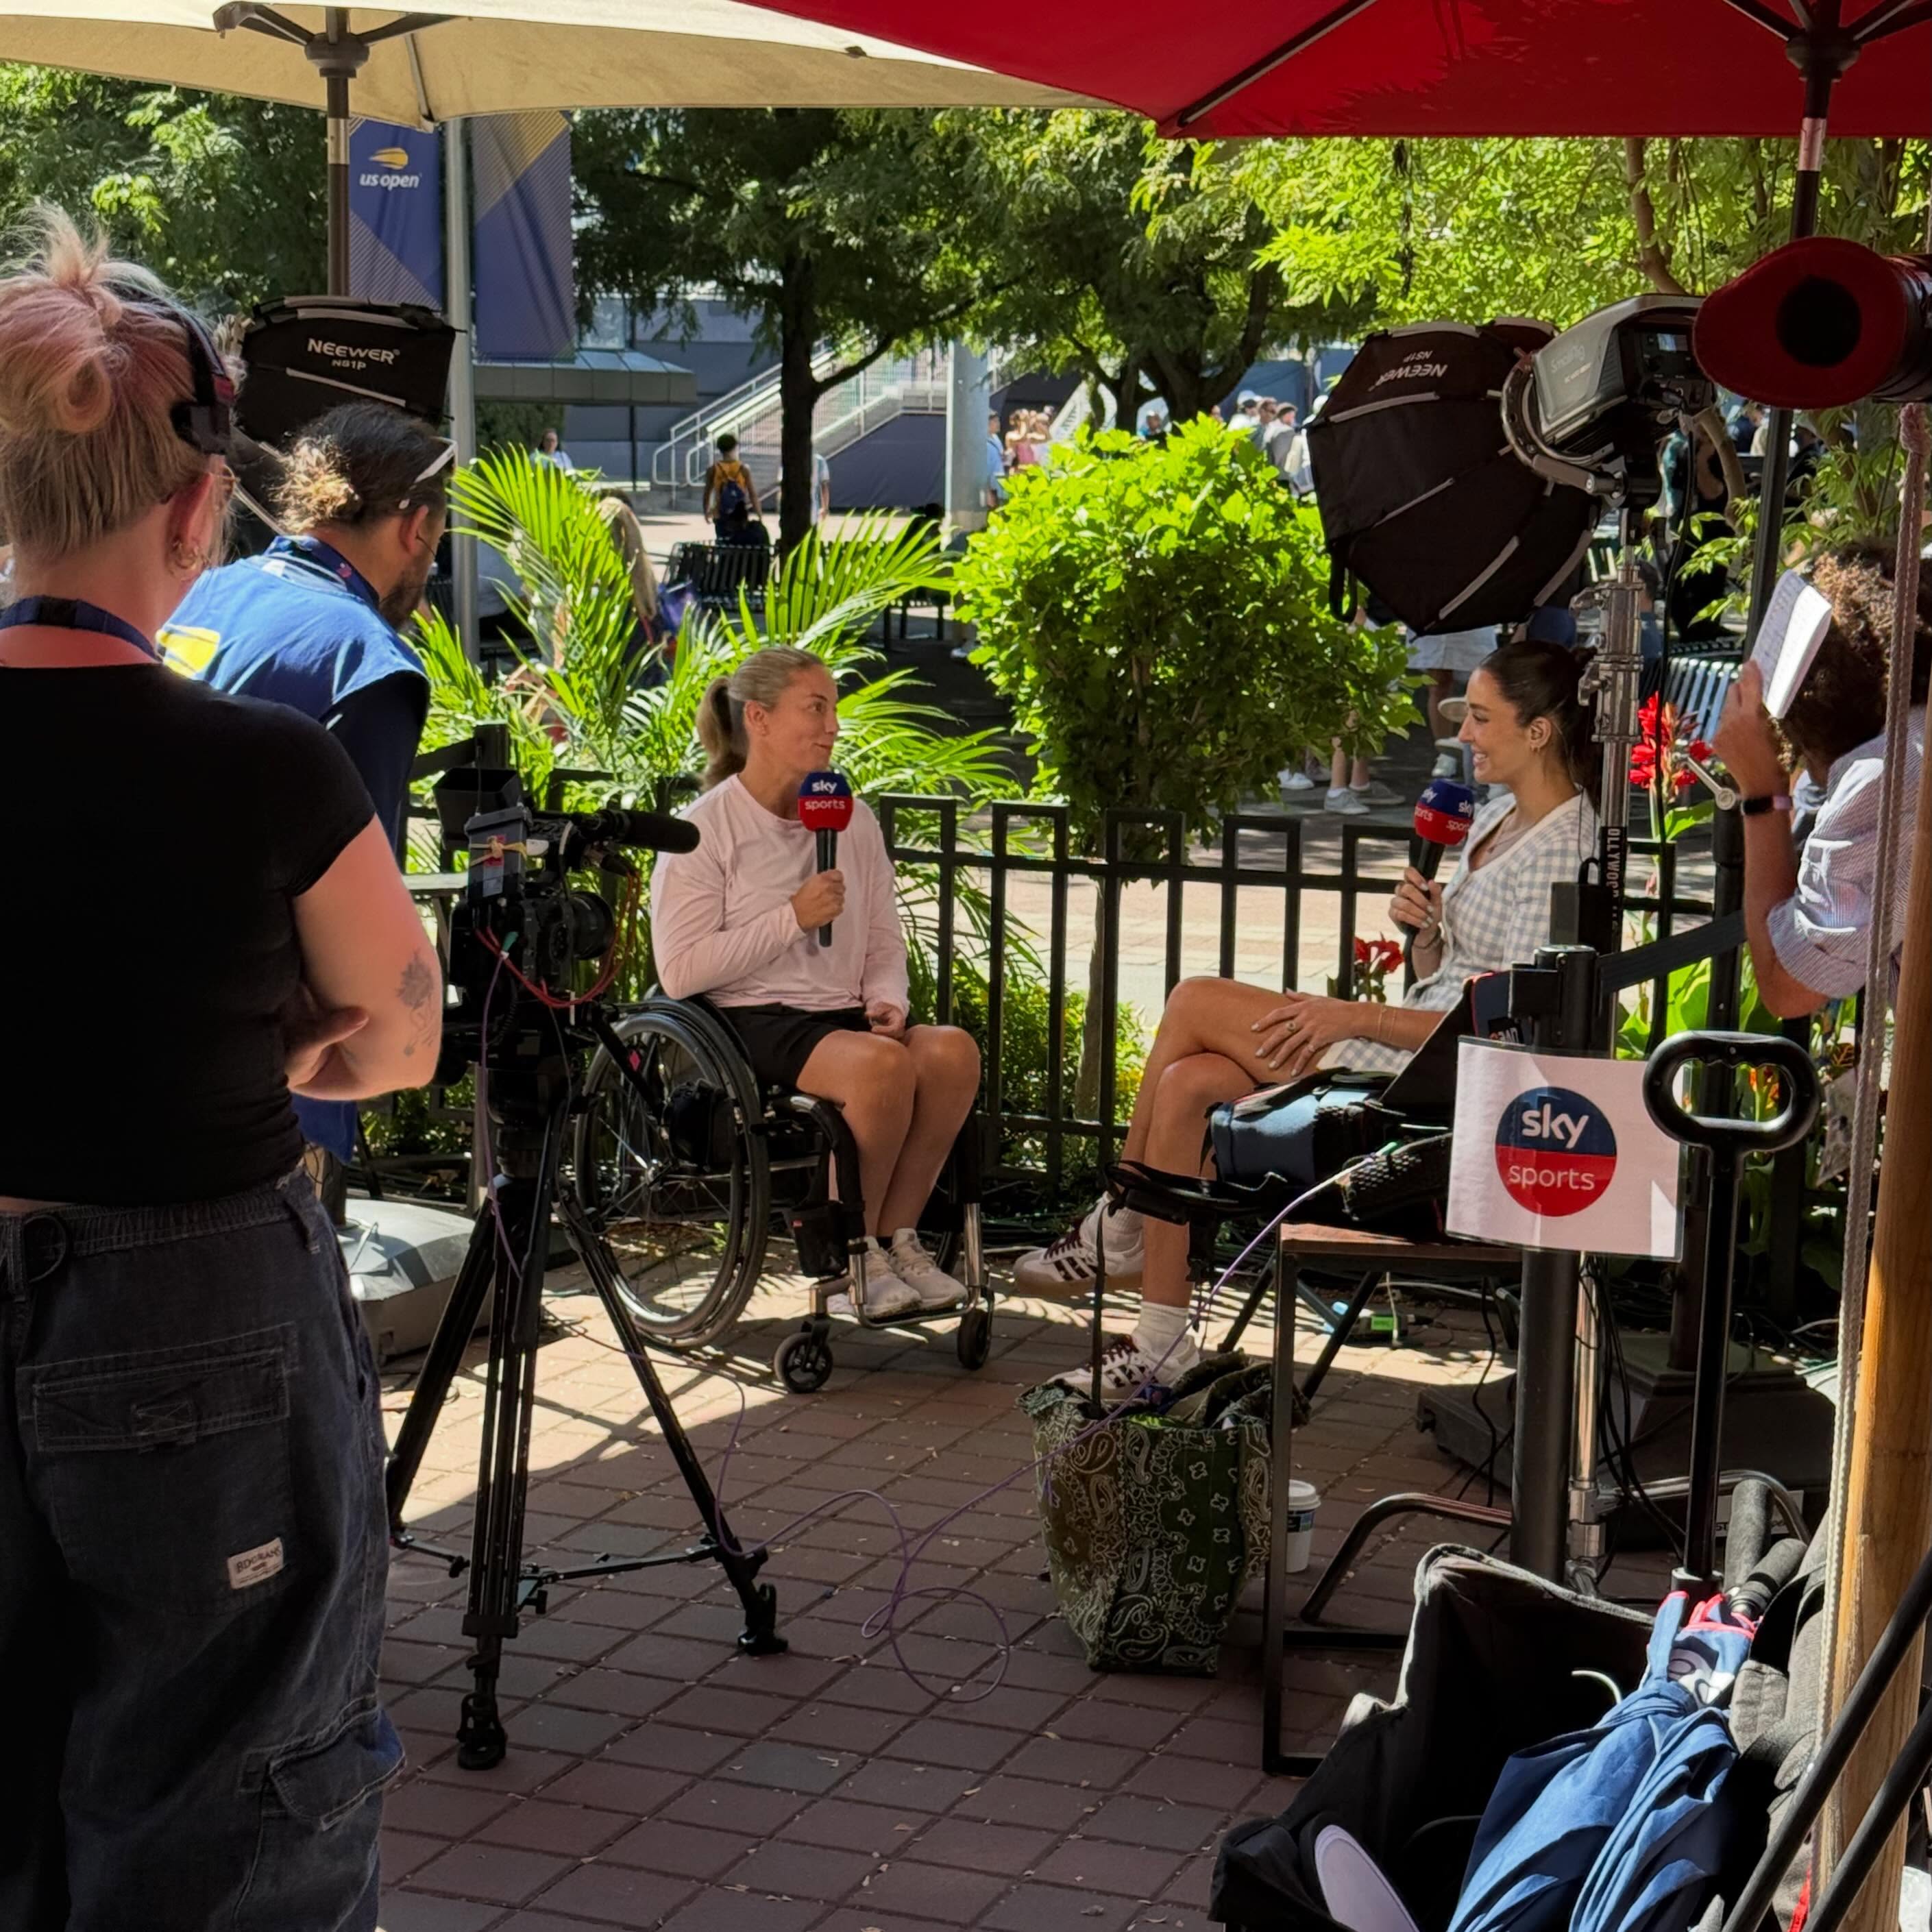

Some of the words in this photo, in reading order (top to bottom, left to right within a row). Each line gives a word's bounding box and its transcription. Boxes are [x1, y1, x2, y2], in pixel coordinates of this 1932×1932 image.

[360, 173, 379, 187] us
[380, 173, 419, 191] open
[307, 338, 395, 365] NEEWER
[811, 779, 837, 794] sky
[804, 799, 846, 812] sports
[1521, 1103, 1590, 1149] sky
[1509, 1165, 1596, 1191] sports
